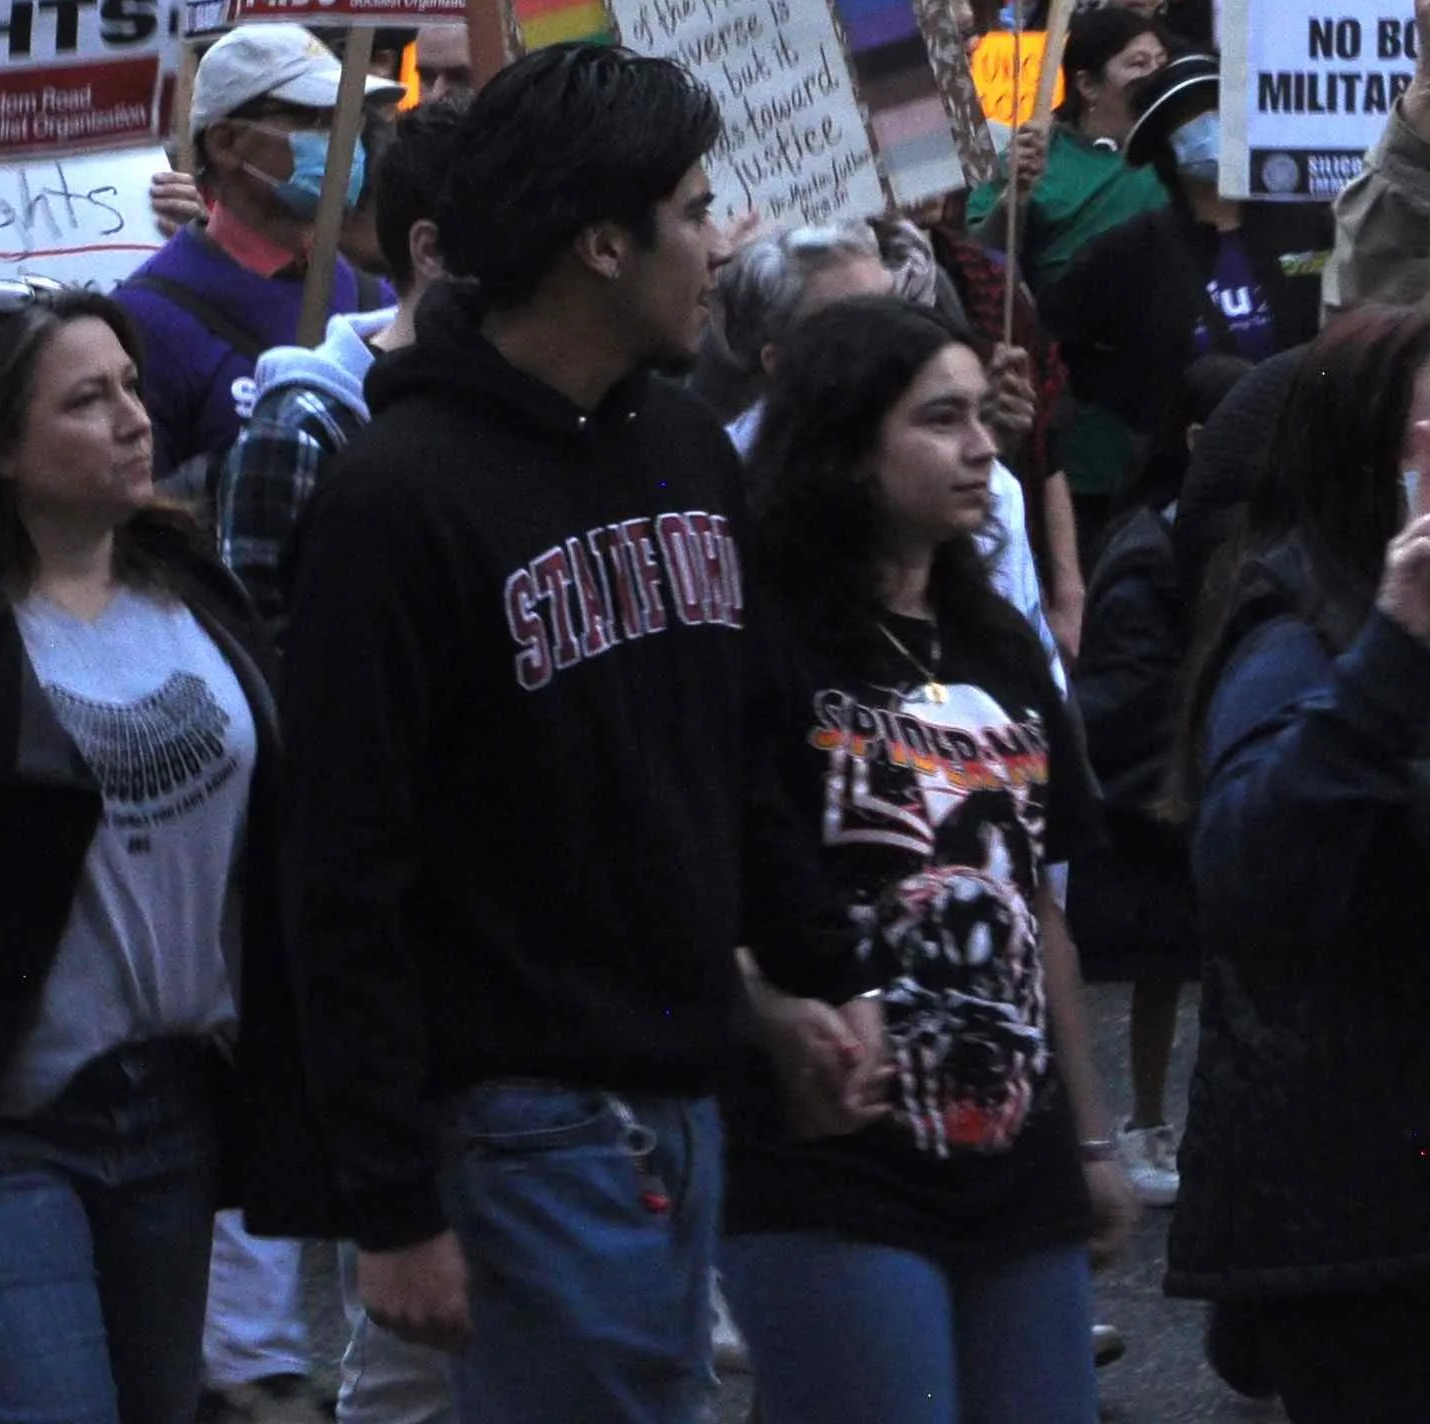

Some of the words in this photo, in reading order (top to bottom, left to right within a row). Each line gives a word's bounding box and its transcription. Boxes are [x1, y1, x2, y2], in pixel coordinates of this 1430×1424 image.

[1309, 18, 1361, 60] NO
[43, 83, 92, 111] Road
[743, 46, 841, 142] toward
